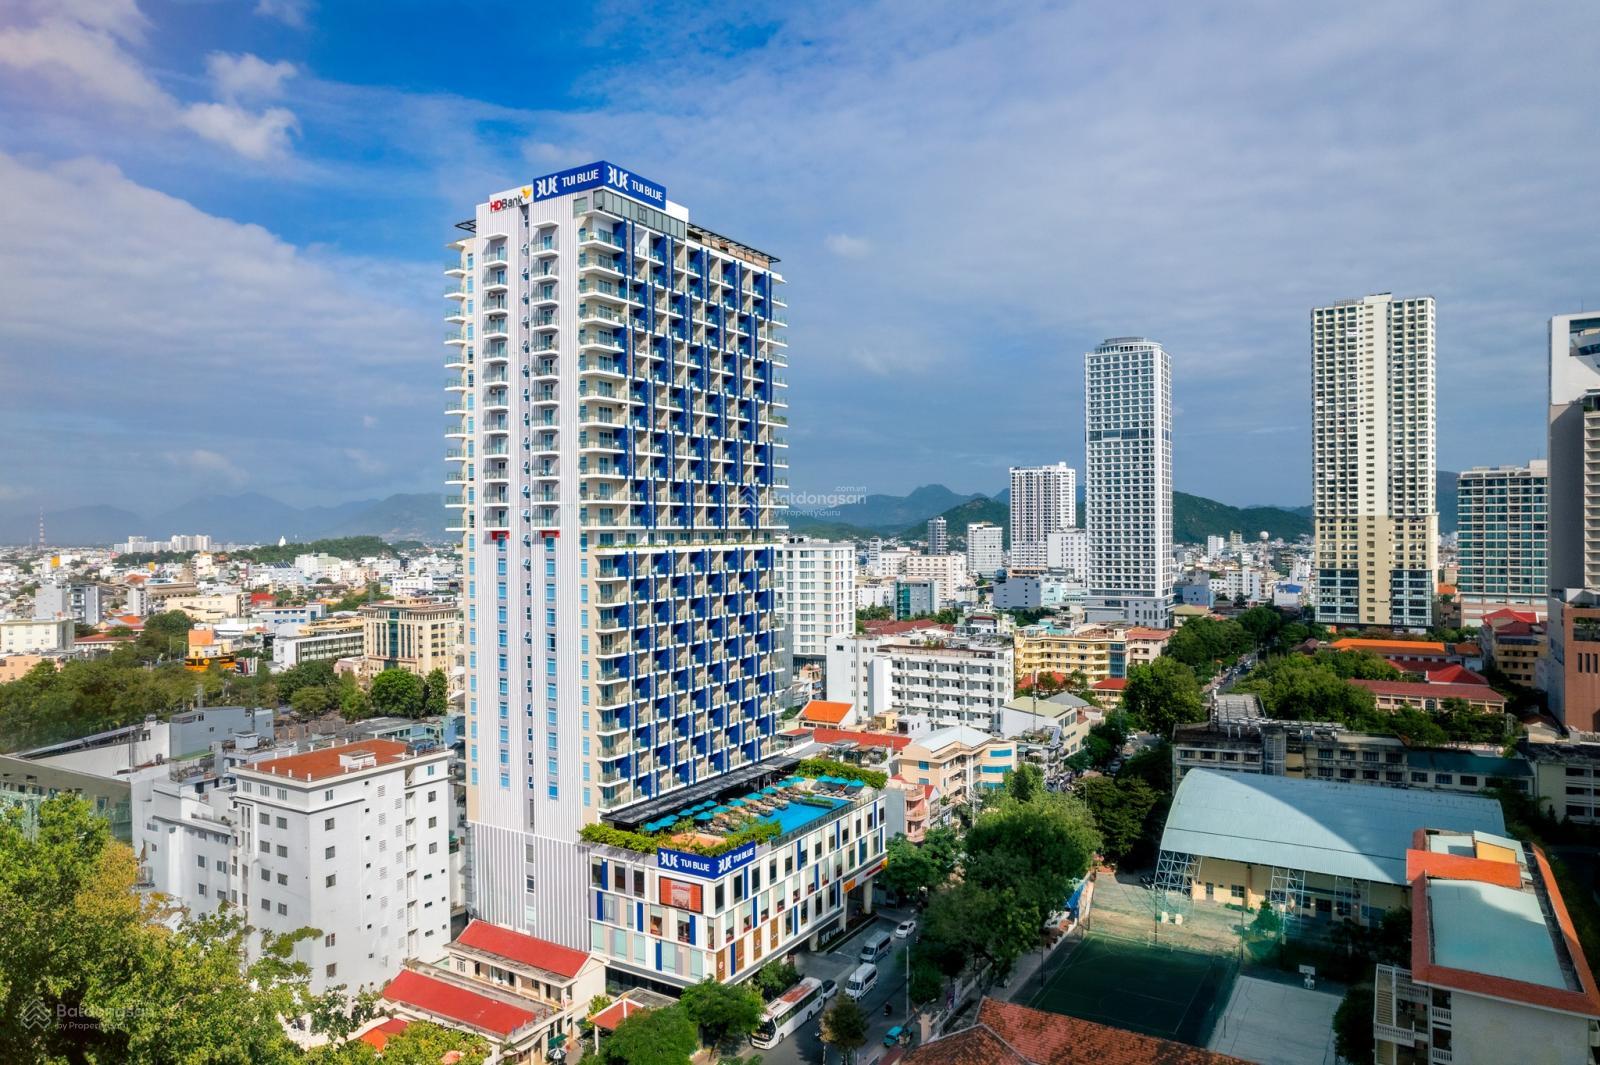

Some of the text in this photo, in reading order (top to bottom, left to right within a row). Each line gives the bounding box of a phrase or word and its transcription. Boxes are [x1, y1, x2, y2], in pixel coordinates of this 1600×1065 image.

[561, 175, 576, 188] TUI
[577, 169, 600, 184] BLUE
[630, 180, 644, 194] TUI
[644, 185, 663, 202] BLUE
[490, 194, 523, 212] HDBank
[733, 853, 742, 863] TUI
[741, 847, 754, 859] BLUE
[680, 858, 692, 868] TUI
[692, 861, 710, 872] BLUE
